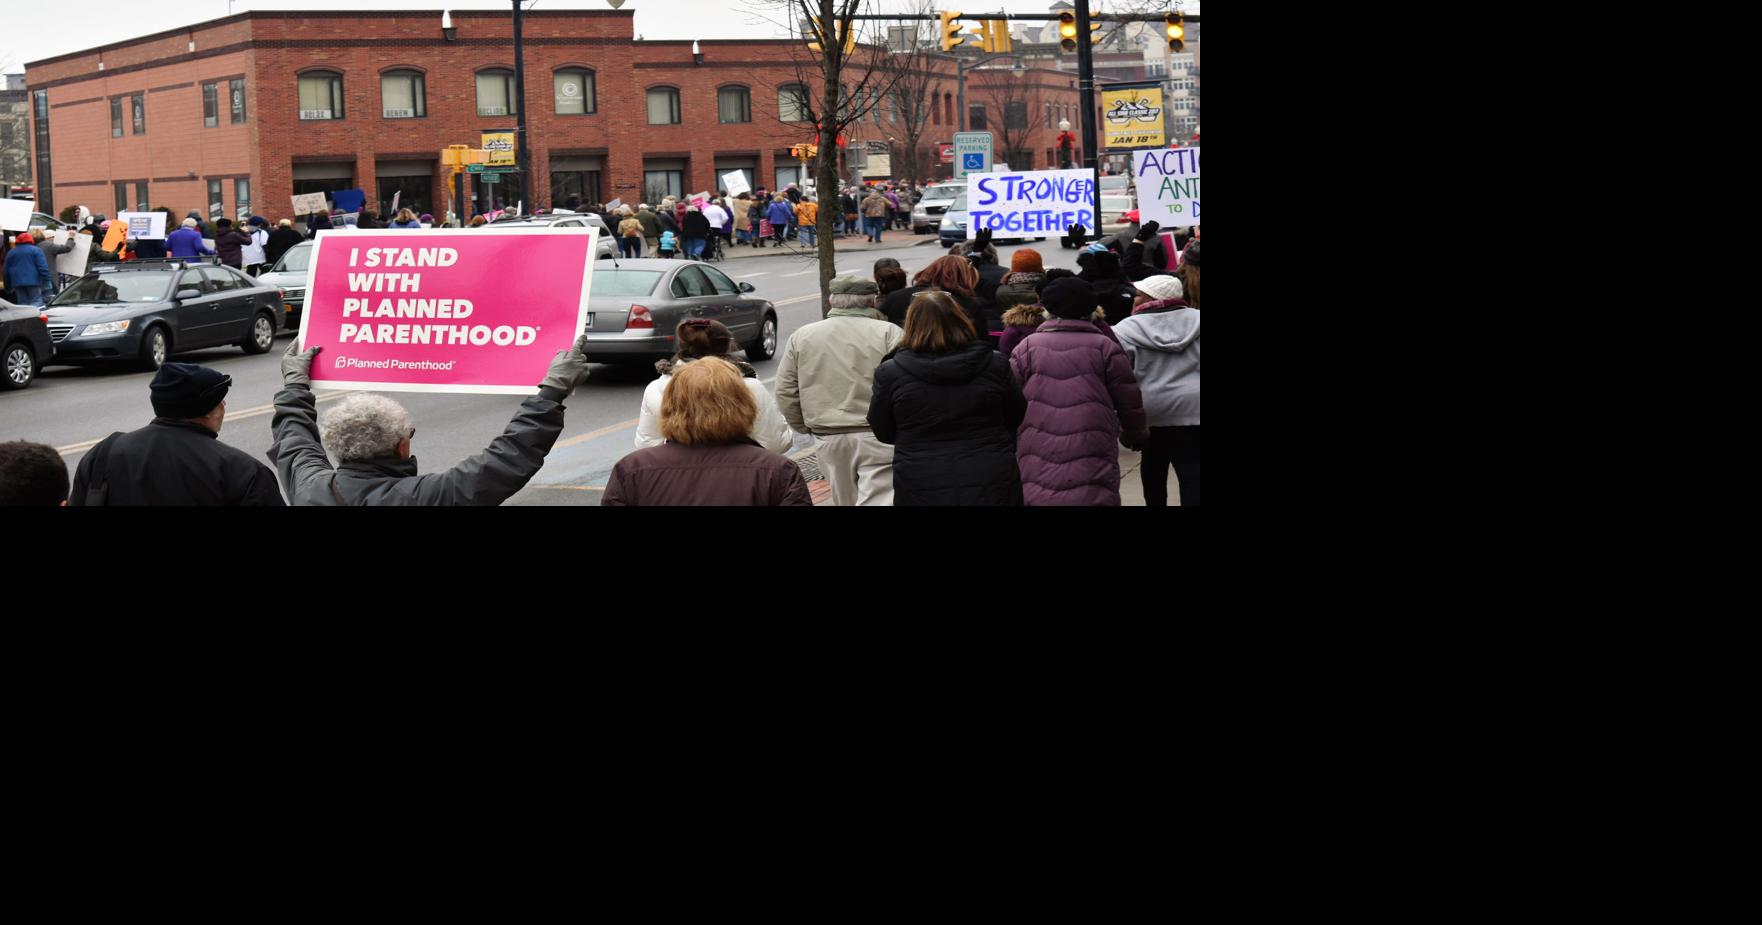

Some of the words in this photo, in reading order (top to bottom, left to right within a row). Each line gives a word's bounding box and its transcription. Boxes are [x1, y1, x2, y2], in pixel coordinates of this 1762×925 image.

[1138, 148, 1200, 177] ACTI
[977, 175, 1095, 206] STRONGER
[1166, 204, 1183, 214] TO
[969, 208, 1094, 233] TOGETHER
[349, 248, 358, 267] I
[364, 247, 459, 268] STAND
[348, 272, 421, 293] WITH
[342, 298, 474, 319] PLANNED
[339, 323, 538, 347] PARENTHOOD
[347, 358, 390, 370] Planned
[390, 359, 453, 371] Parenthood
